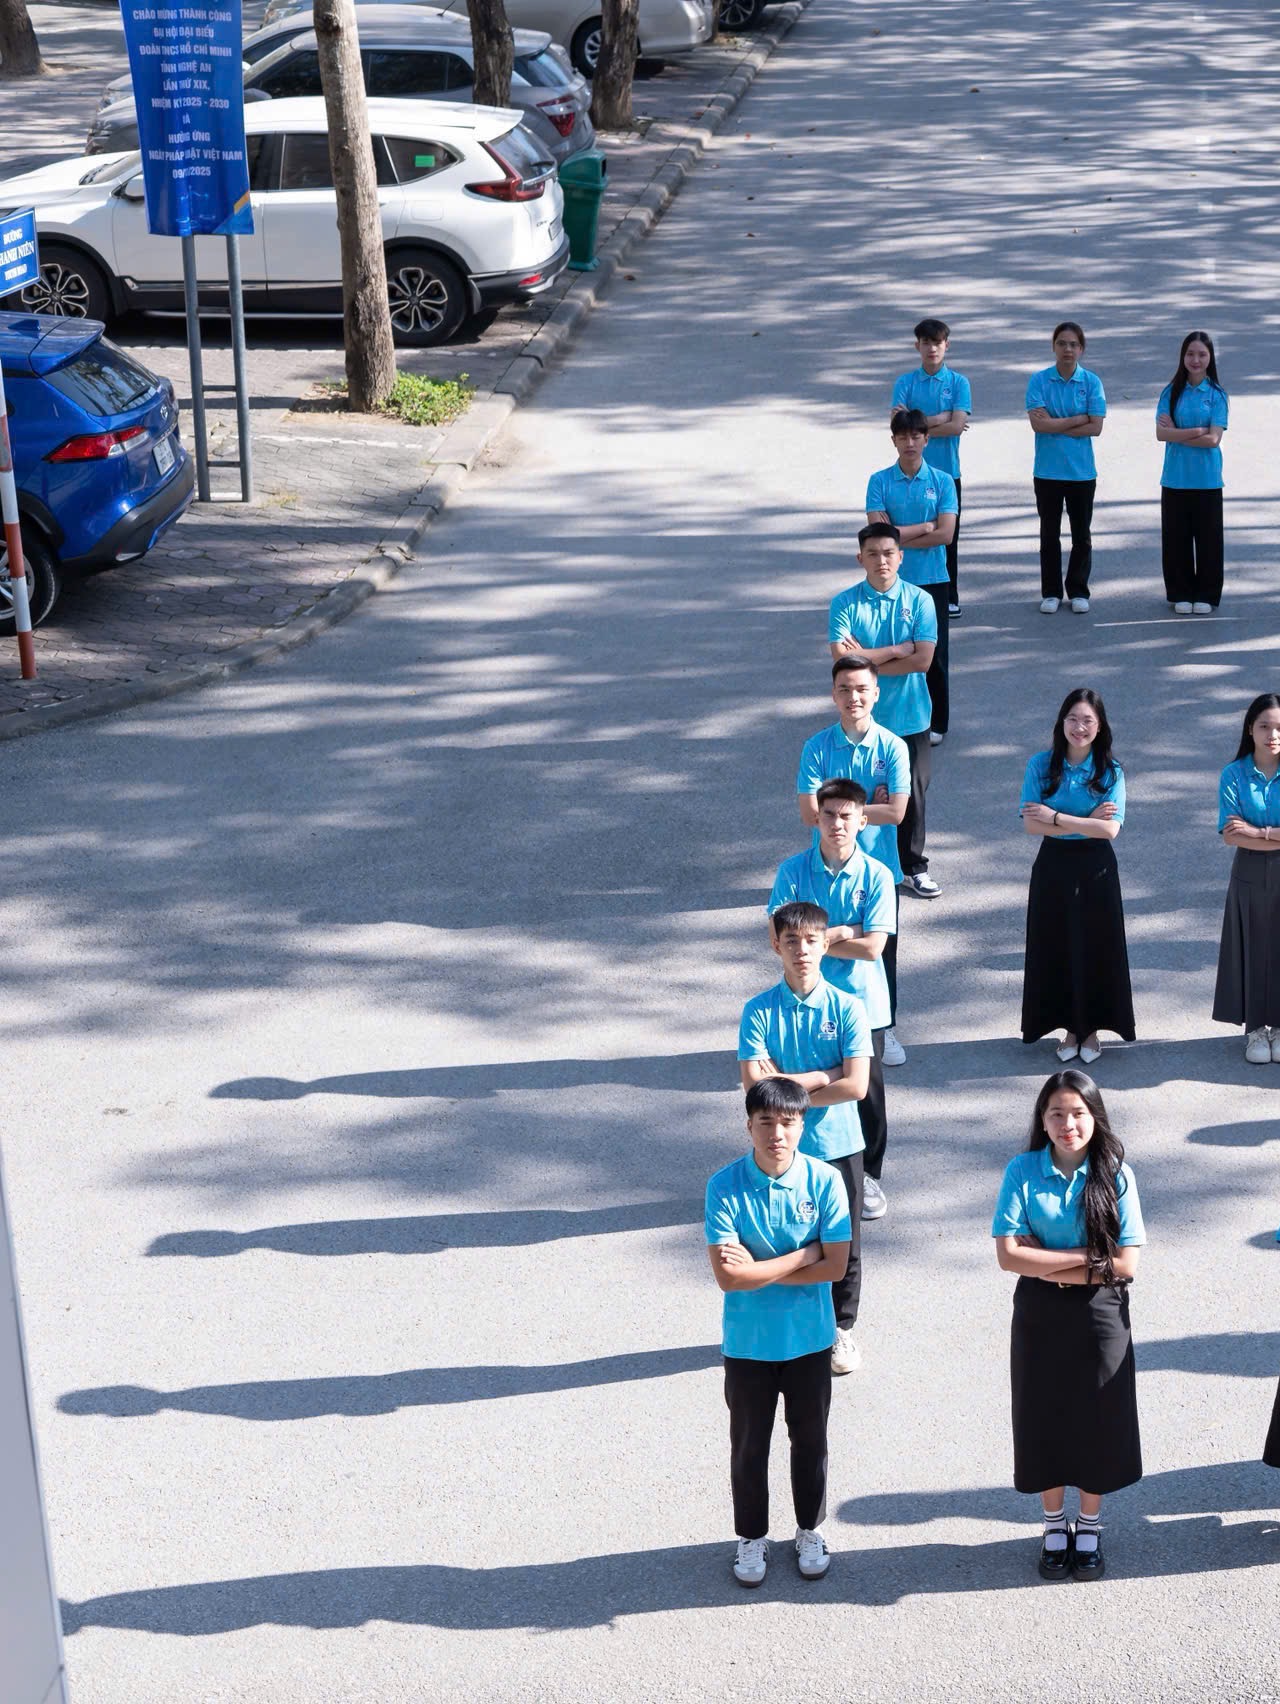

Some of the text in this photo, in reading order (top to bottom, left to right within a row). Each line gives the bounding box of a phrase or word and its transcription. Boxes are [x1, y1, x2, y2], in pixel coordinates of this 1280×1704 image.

[179, 8, 207, 20] THÀNH
[208, 10, 232, 21] CÔNG
[179, 26, 194, 38] ĐẠI
[209, 46, 232, 56] MINH
[200, 62, 212, 73] AN
[183, 96, 202, 107] 2025
[209, 97, 230, 109] 2030
[165, 149, 184, 161] PHÁP
[203, 149, 220, 161] VIỆT
[222, 151, 243, 160] NAM
